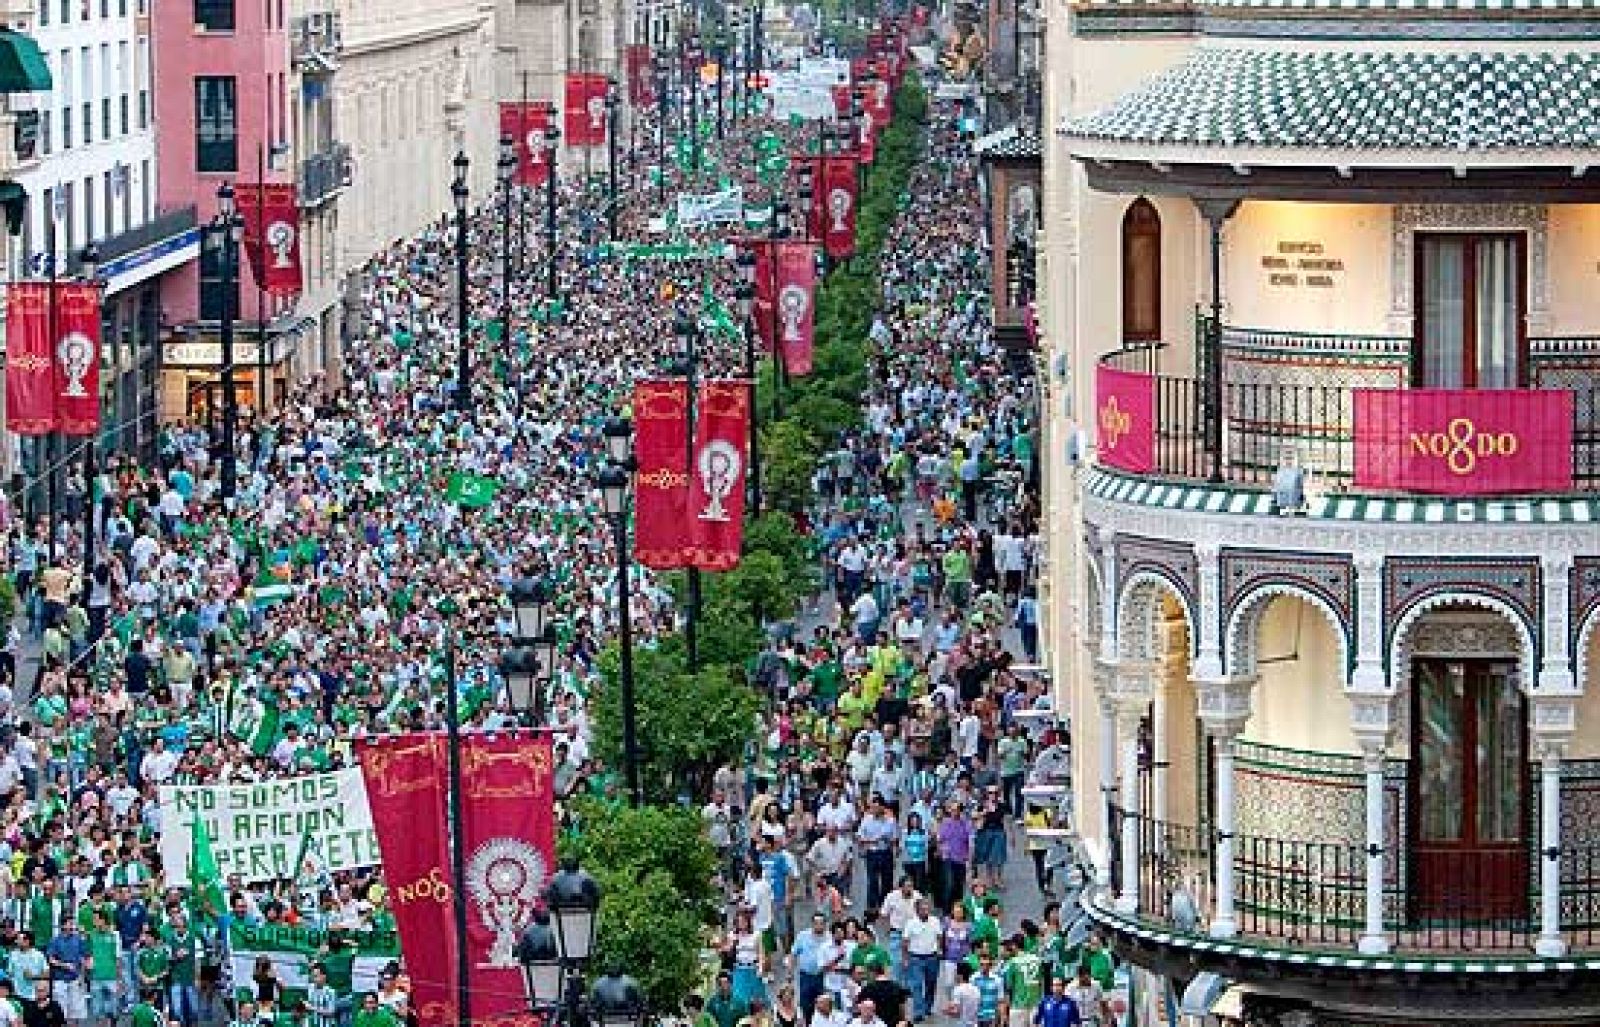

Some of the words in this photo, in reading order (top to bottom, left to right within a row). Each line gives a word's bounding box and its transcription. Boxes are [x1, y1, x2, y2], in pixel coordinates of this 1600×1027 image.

[174, 787, 216, 812] NO
[229, 776, 339, 809] SOMOS
[234, 803, 345, 841] AFICION
